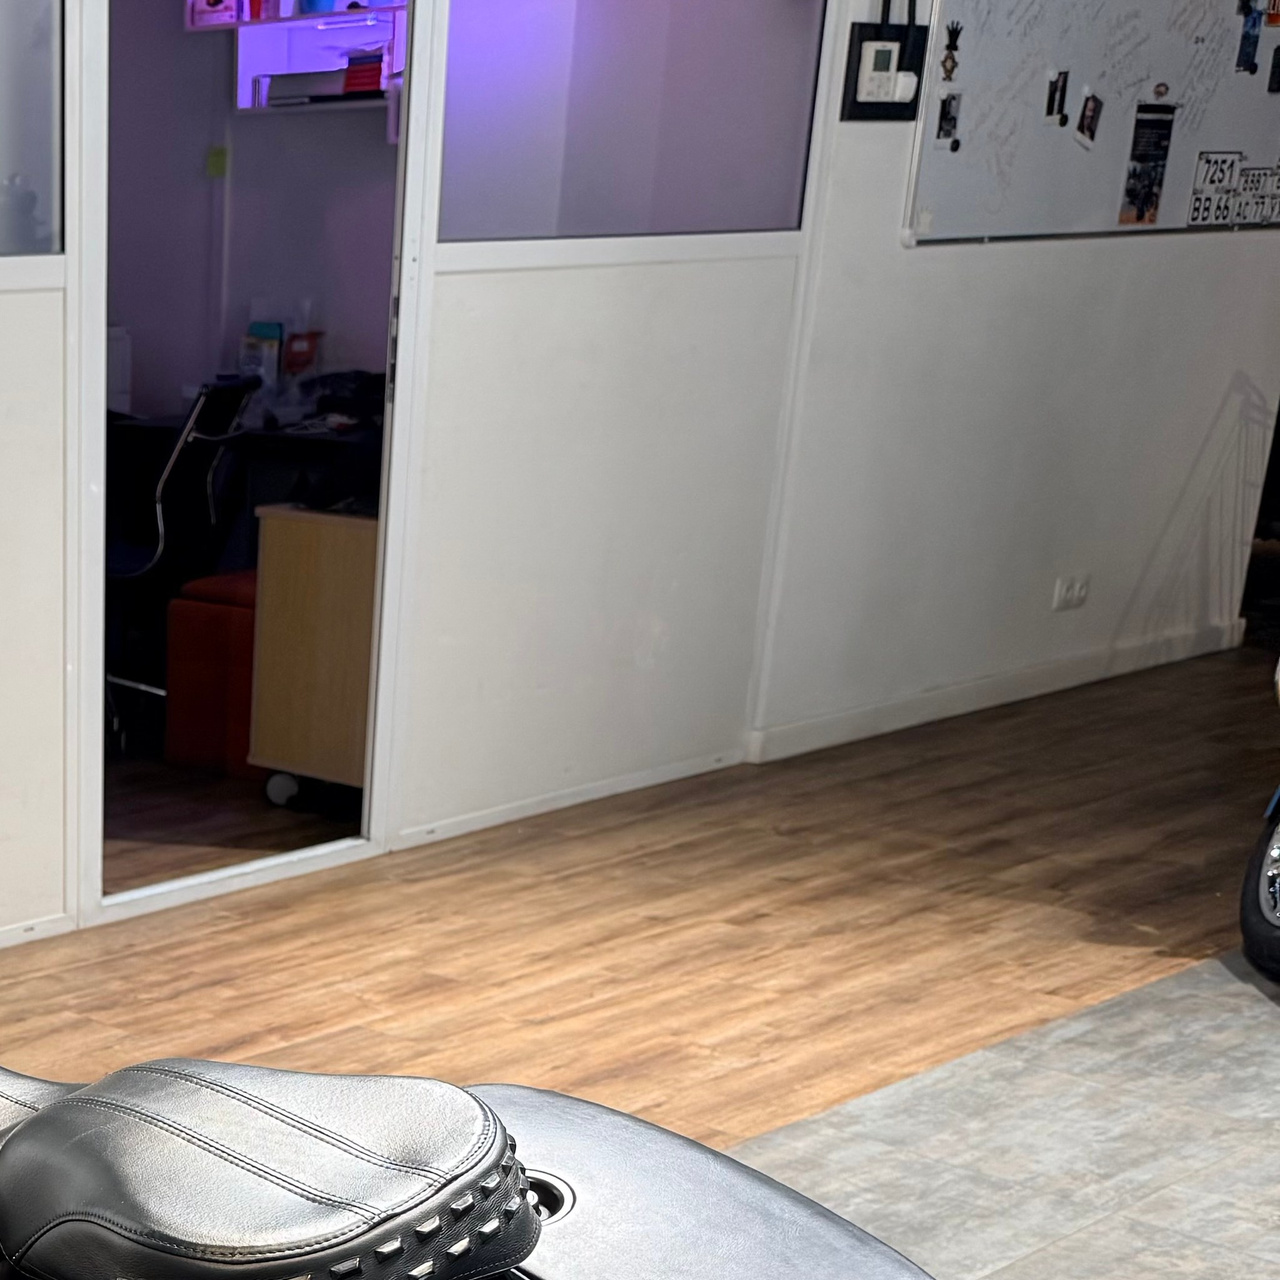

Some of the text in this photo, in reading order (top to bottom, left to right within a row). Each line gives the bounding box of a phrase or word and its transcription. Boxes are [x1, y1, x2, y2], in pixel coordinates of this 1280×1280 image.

[1203, 159, 1235, 184] 7251
[1190, 196, 1230, 222] BB 66
